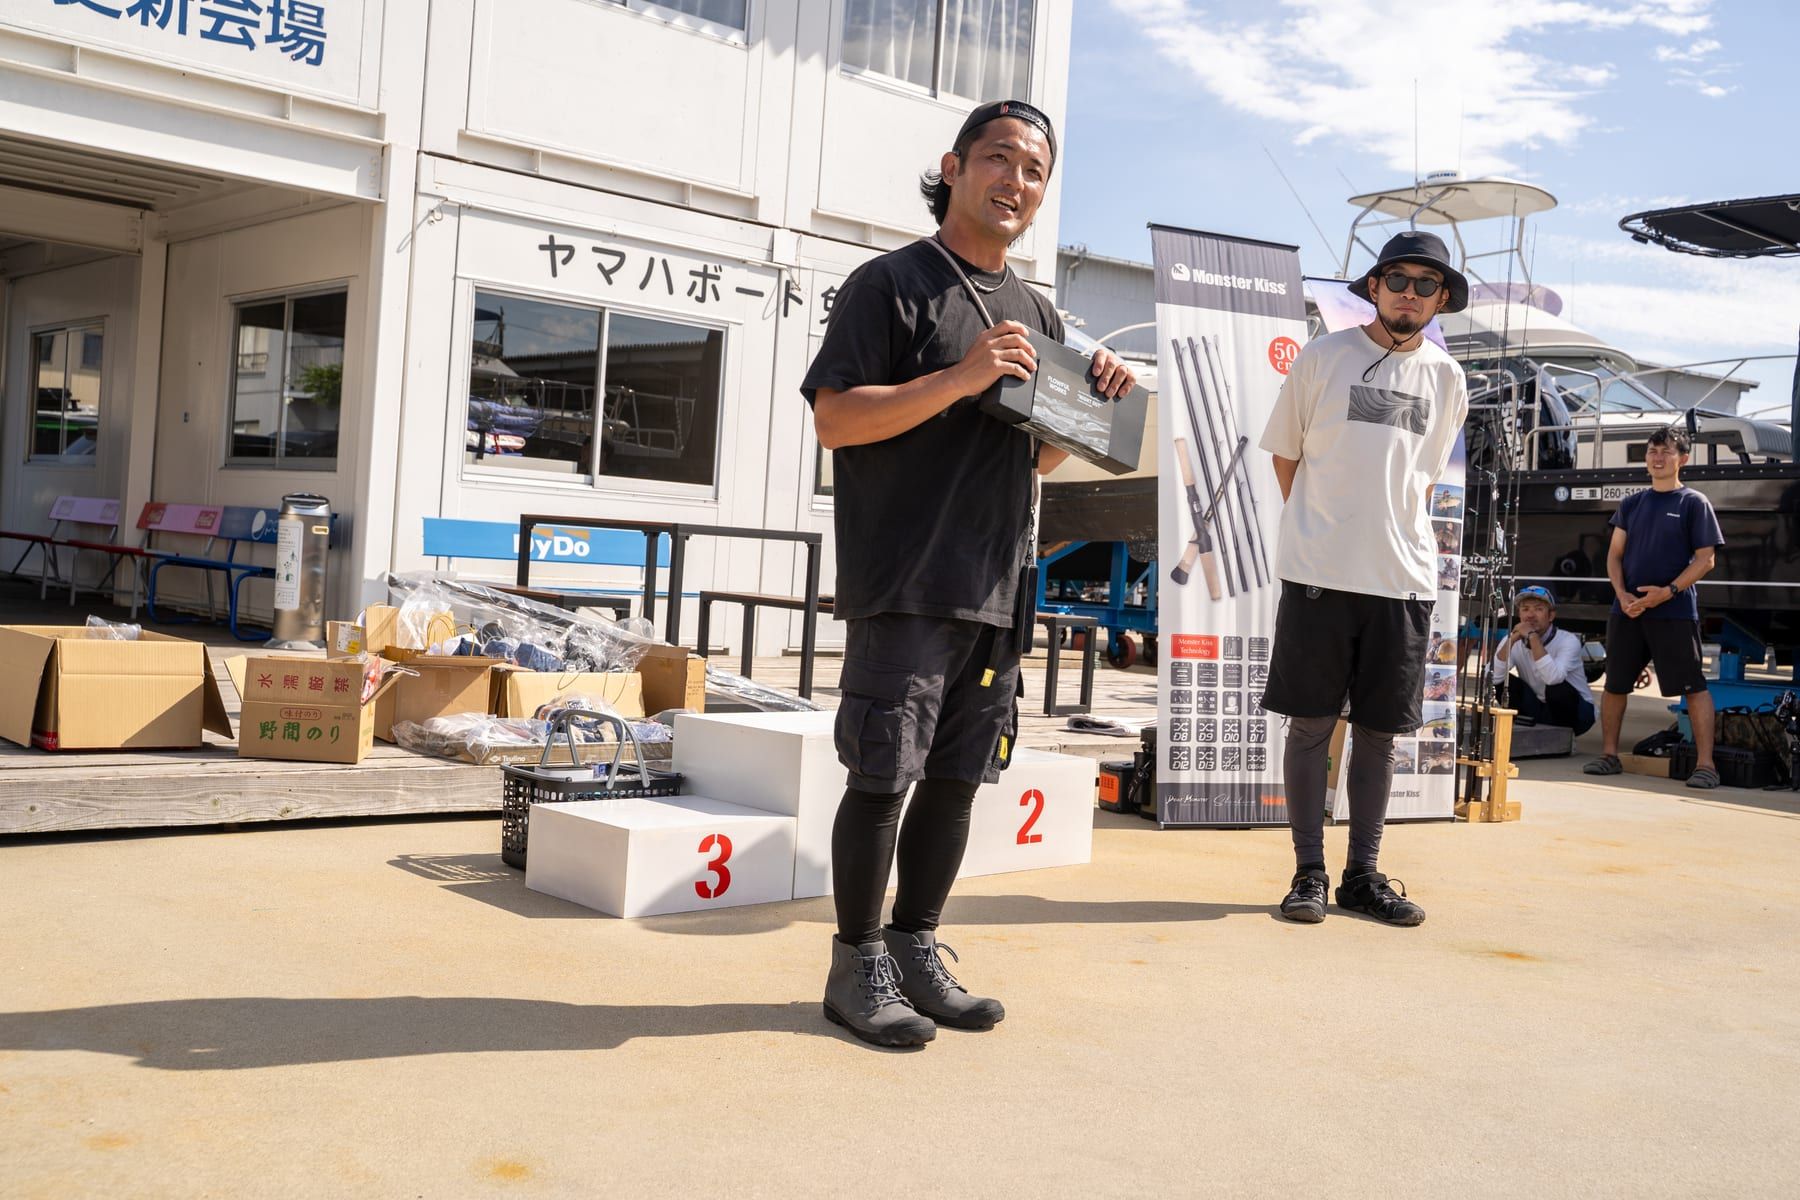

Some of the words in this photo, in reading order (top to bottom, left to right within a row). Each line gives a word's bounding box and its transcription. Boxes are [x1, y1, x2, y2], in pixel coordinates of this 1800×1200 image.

[50, 0, 328, 67] 新会場
[1192, 268, 1253, 290] Monster
[1254, 277, 1286, 295] Kiss
[1274, 342, 1298, 361] 50
[1178, 638, 1201, 646] Monster
[1180, 646, 1211, 656] Technology
[259, 720, 341, 745] 野間のり
[1406, 790, 1421, 798] Kiss
[1016, 789, 1045, 845] 2
[694, 833, 733, 899] 3
